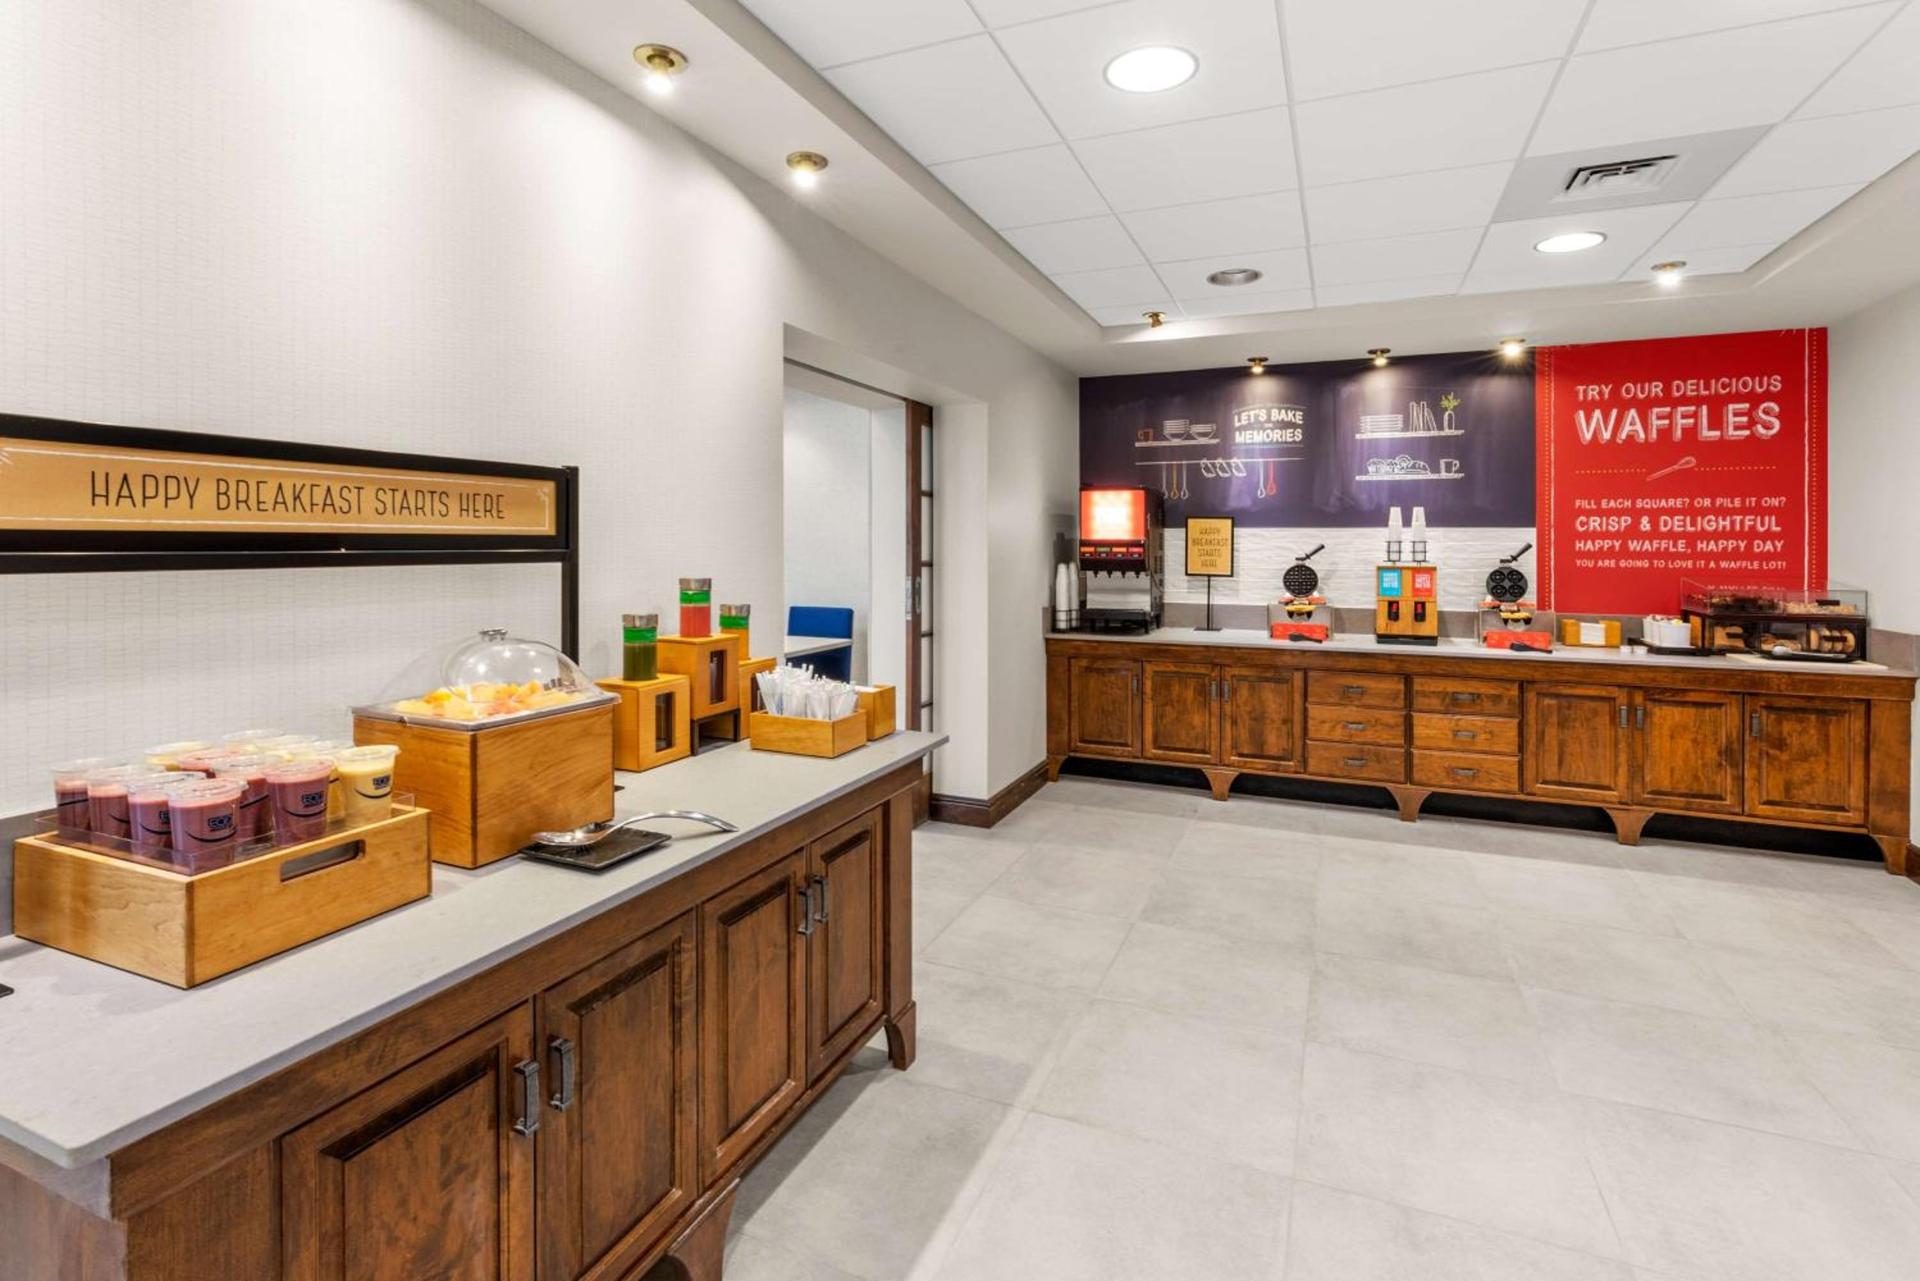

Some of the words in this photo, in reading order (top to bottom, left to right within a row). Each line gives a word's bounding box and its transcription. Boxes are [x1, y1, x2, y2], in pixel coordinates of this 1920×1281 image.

[1575, 384, 1612, 400] TRY
[1621, 381, 1664, 399] OUR
[1671, 375, 1782, 398] DELICIOUS
[1234, 409, 1267, 427] LET'S
[1271, 408, 1304, 424] BAKE
[1574, 401, 1781, 445] WAFFLES
[1235, 428, 1303, 443] MEMORIES
[91, 470, 200, 510] HAPPY
[216, 478, 365, 516] BREAKFAST
[375, 487, 450, 518] STARTS
[459, 492, 505, 519] HERE
[1575, 498, 1597, 509] FILL
[1601, 498, 1632, 508] EACH
[1635, 497, 1690, 509] SQUARE?
[1693, 497, 1711, 508] OR
[1715, 497, 1741, 508] PILE
[1745, 497, 1757, 507] IT
[1761, 496, 1786, 508] ON?
[1575, 515, 1632, 532] CRISP
[1640, 515, 1651, 532] &
[1659, 514, 1782, 533] DELIGHTFUL
[1575, 540, 1622, 552] HAPPY
[1628, 540, 1692, 553] WAFFLE,
[1696, 540, 1747, 552] HAPPY
[1753, 540, 1784, 552] DAY
[1576, 559, 1595, 568] YOU
[1597, 559, 1616, 568] ARE
[1619, 559, 1649, 568] GOING
[1653, 559, 1666, 568] TO
[1668, 560, 1693, 568] LOVE
[1696, 560, 1706, 568] IT
[1708, 560, 1716, 569] A
[1719, 560, 1760, 569] WAFFLE
[1762, 560, 1786, 569] LOT!
